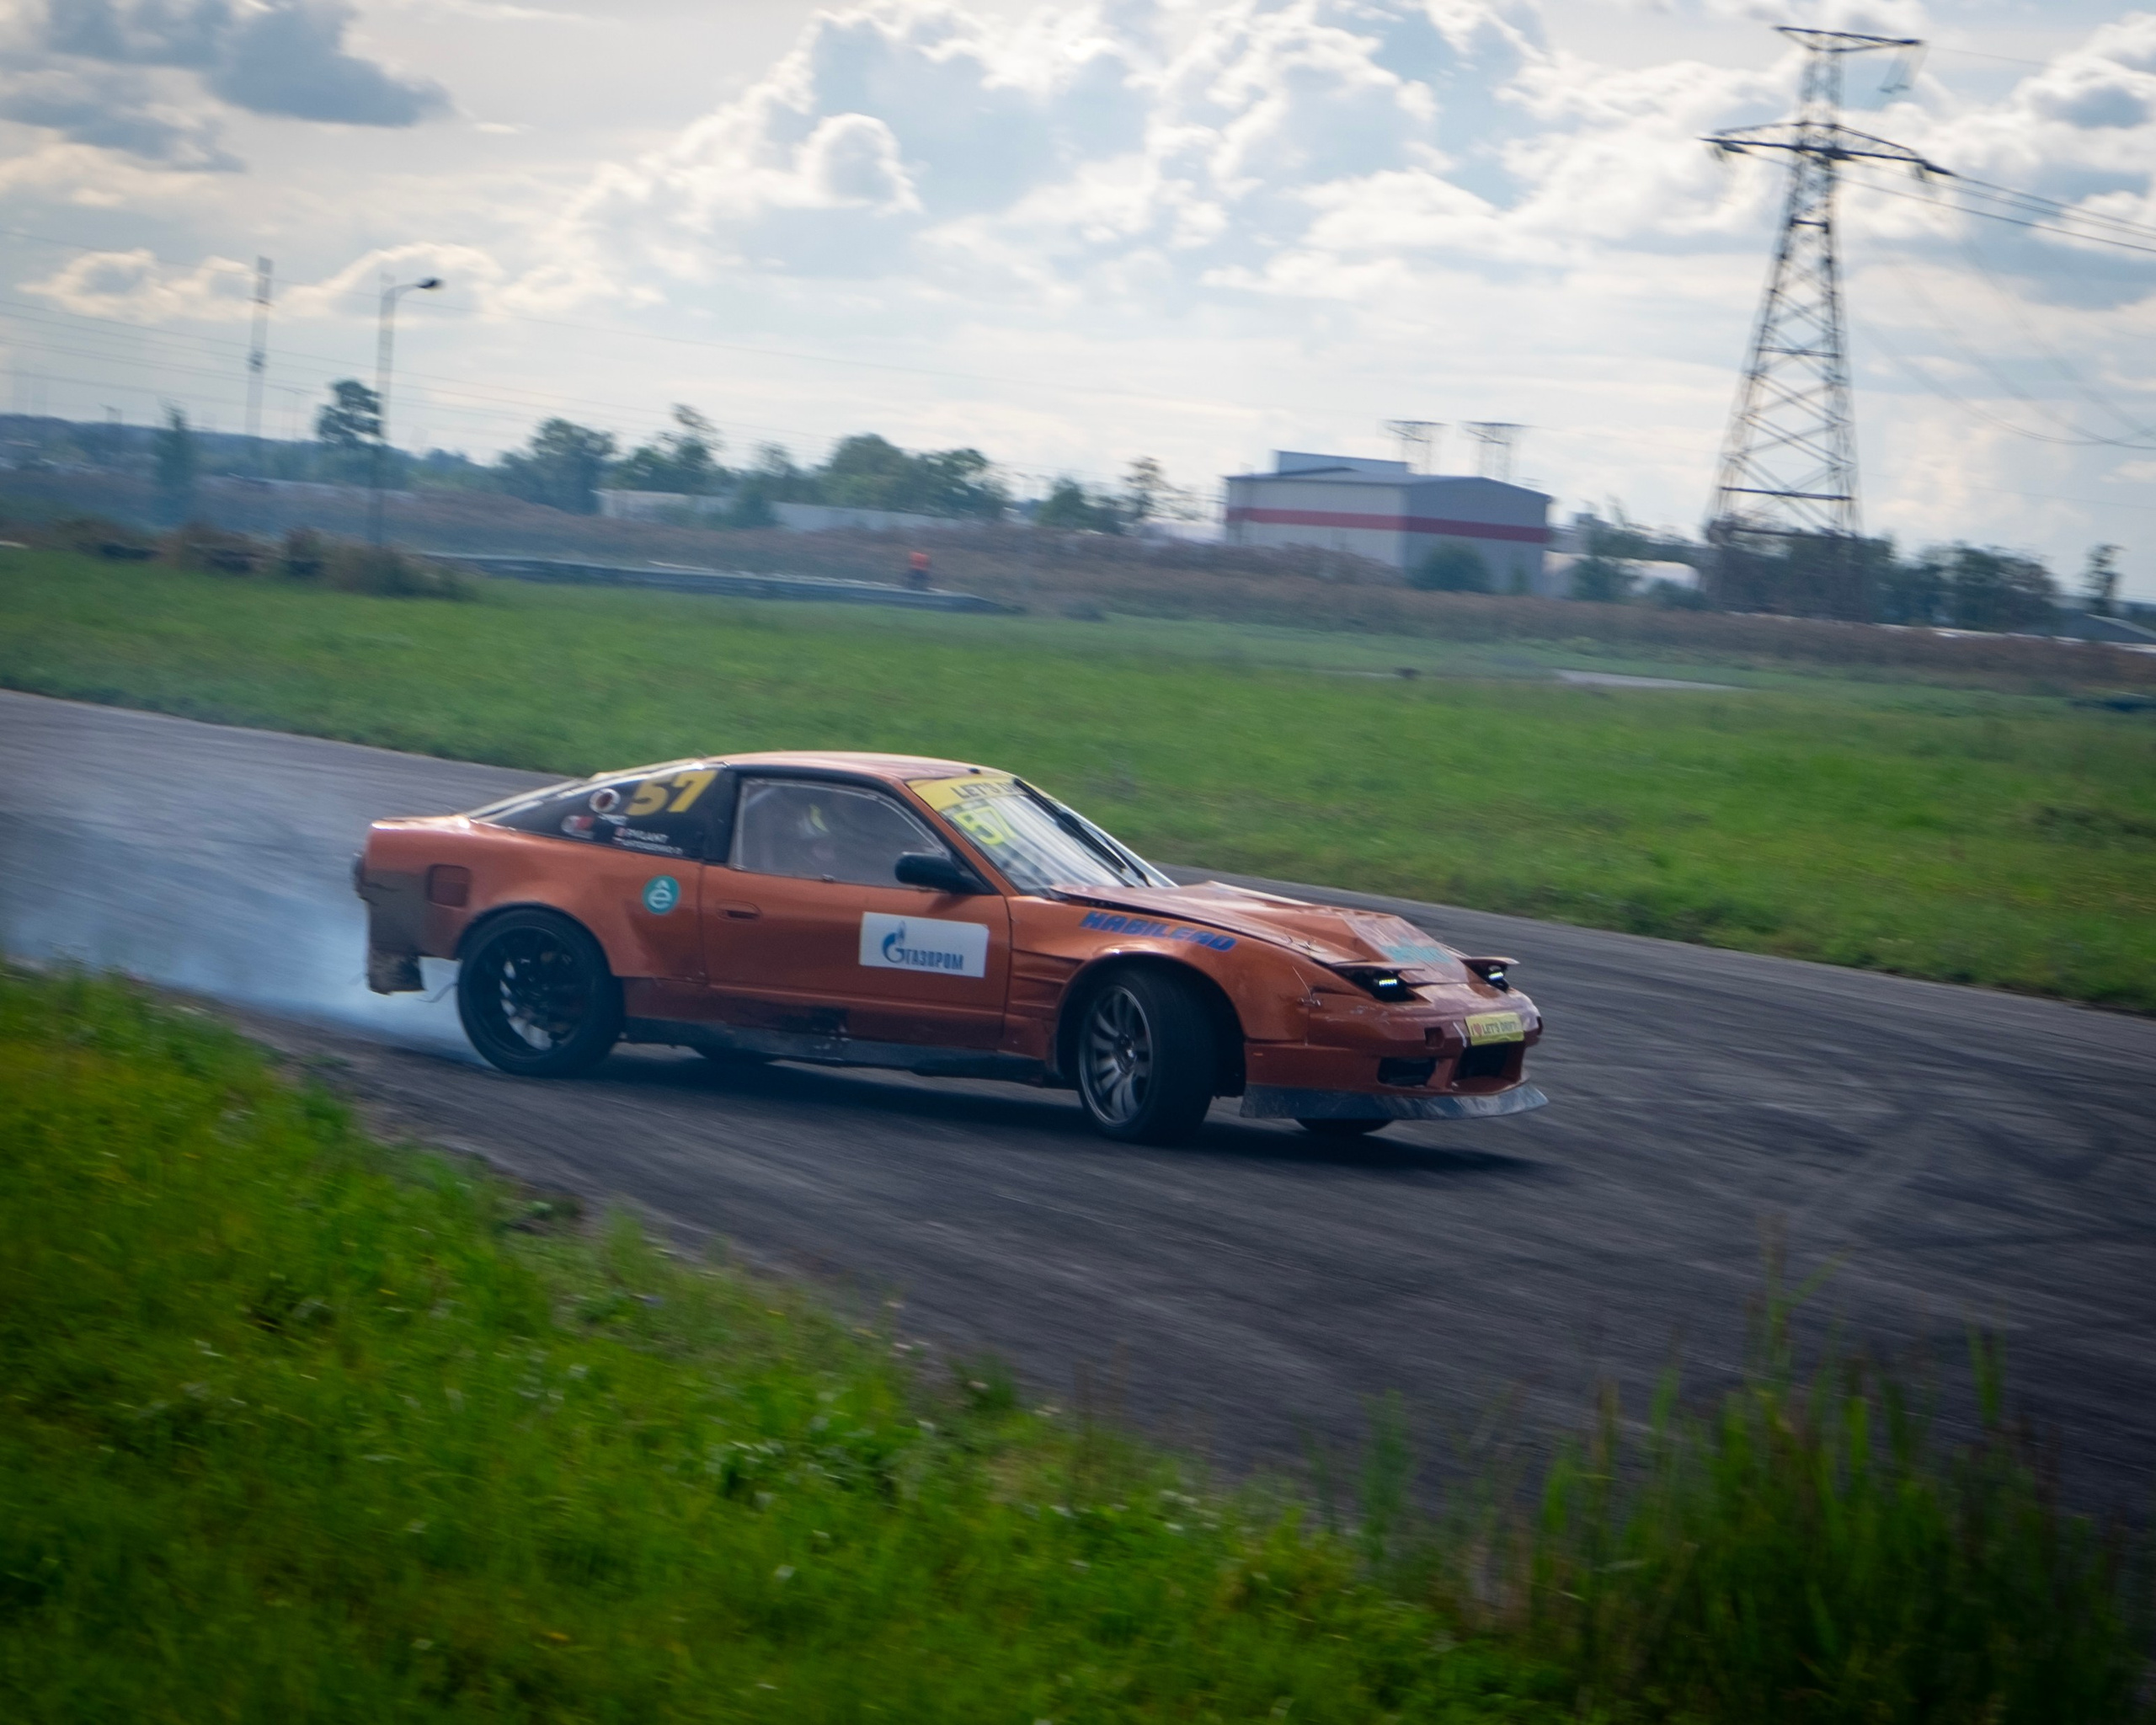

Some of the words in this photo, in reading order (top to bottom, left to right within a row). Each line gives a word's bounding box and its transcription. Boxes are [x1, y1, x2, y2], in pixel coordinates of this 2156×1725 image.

[625, 770, 717, 815] 57
[950, 782, 1001, 798] LET'S
[953, 805, 1017, 845] 57
[1080, 911, 1237, 953] HABILEAD
[905, 948, 964, 970] ГАЗПРОМ
[1482, 1022, 1500, 1034] LET'S
